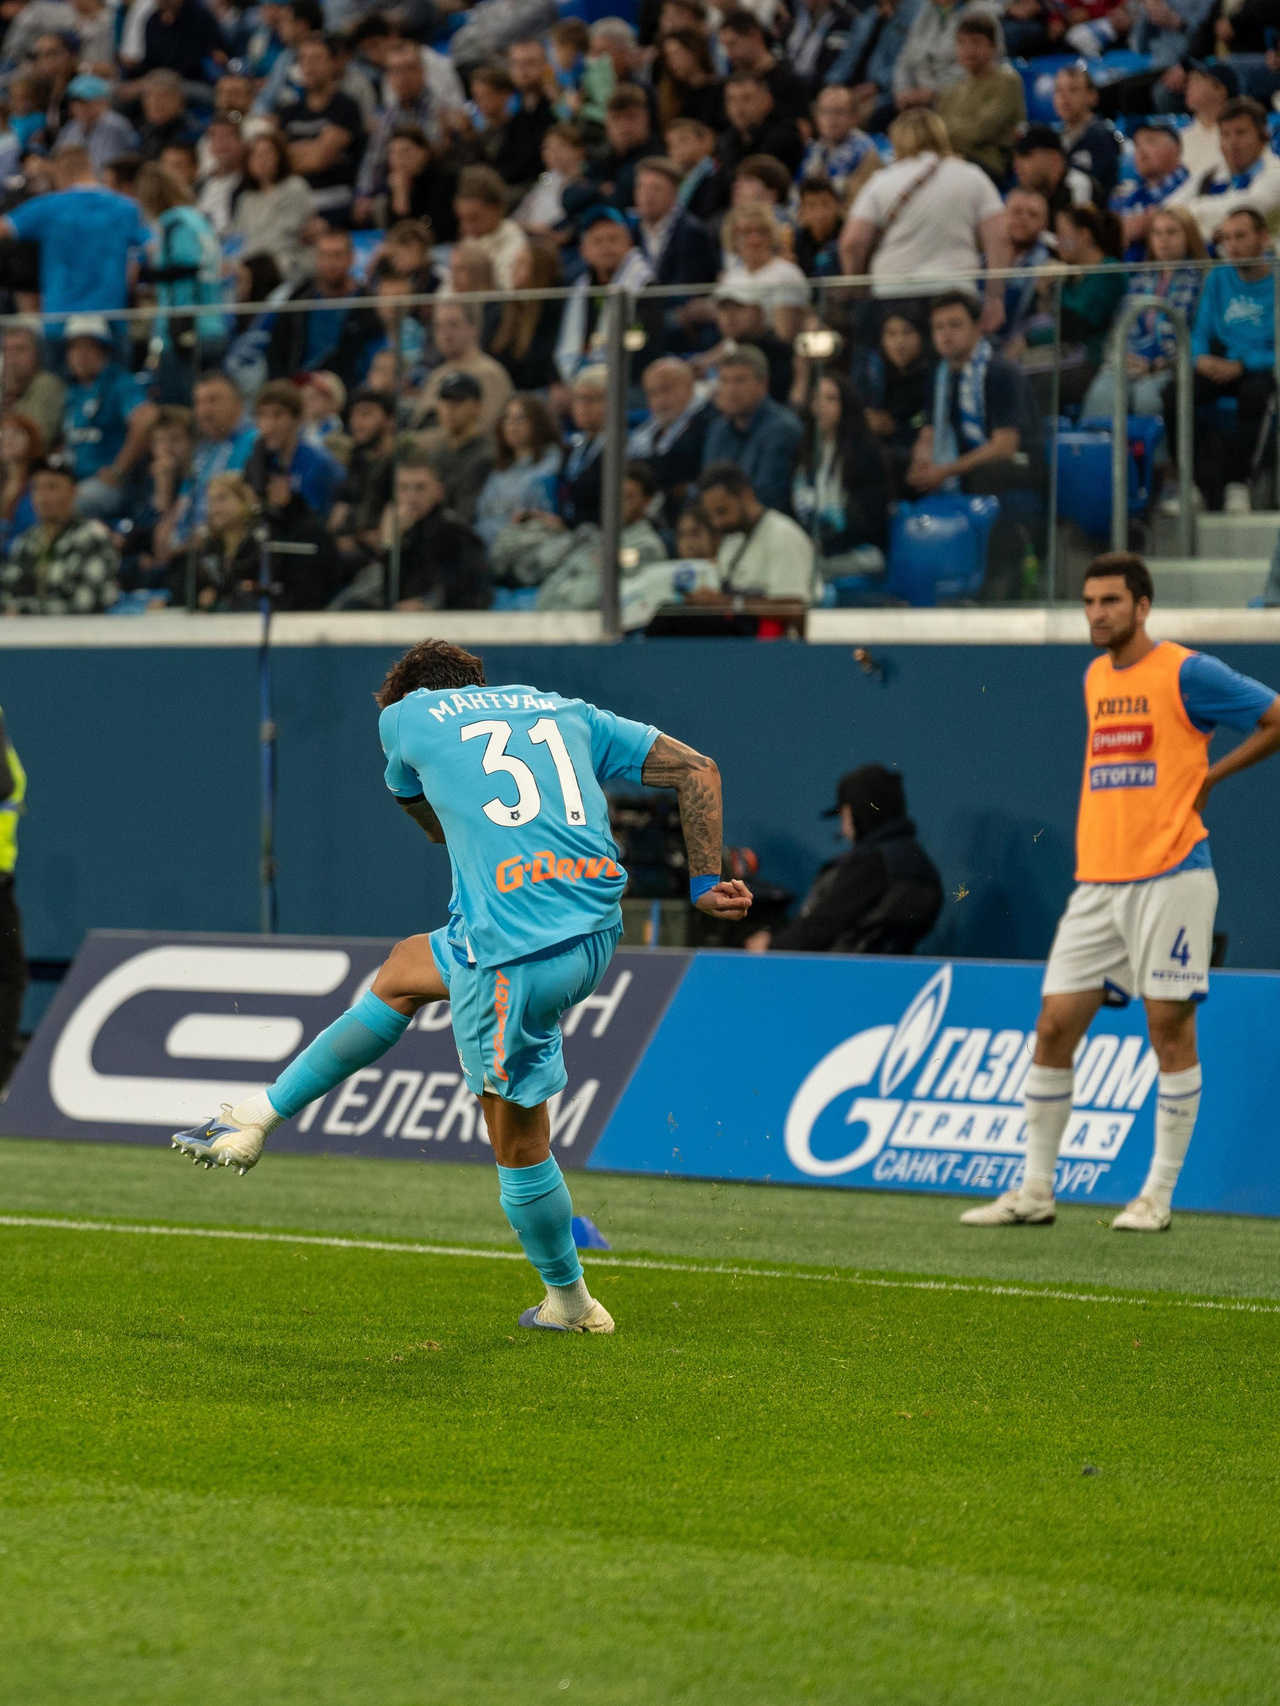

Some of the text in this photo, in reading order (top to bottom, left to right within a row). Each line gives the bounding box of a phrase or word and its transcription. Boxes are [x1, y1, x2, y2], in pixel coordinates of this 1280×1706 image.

[460, 717, 588, 828] 31
[1170, 924, 1191, 967] 4
[298, 1067, 600, 1147] ЕЛЕКМ
[912, 1026, 1159, 1111] ГАЗПОМ
